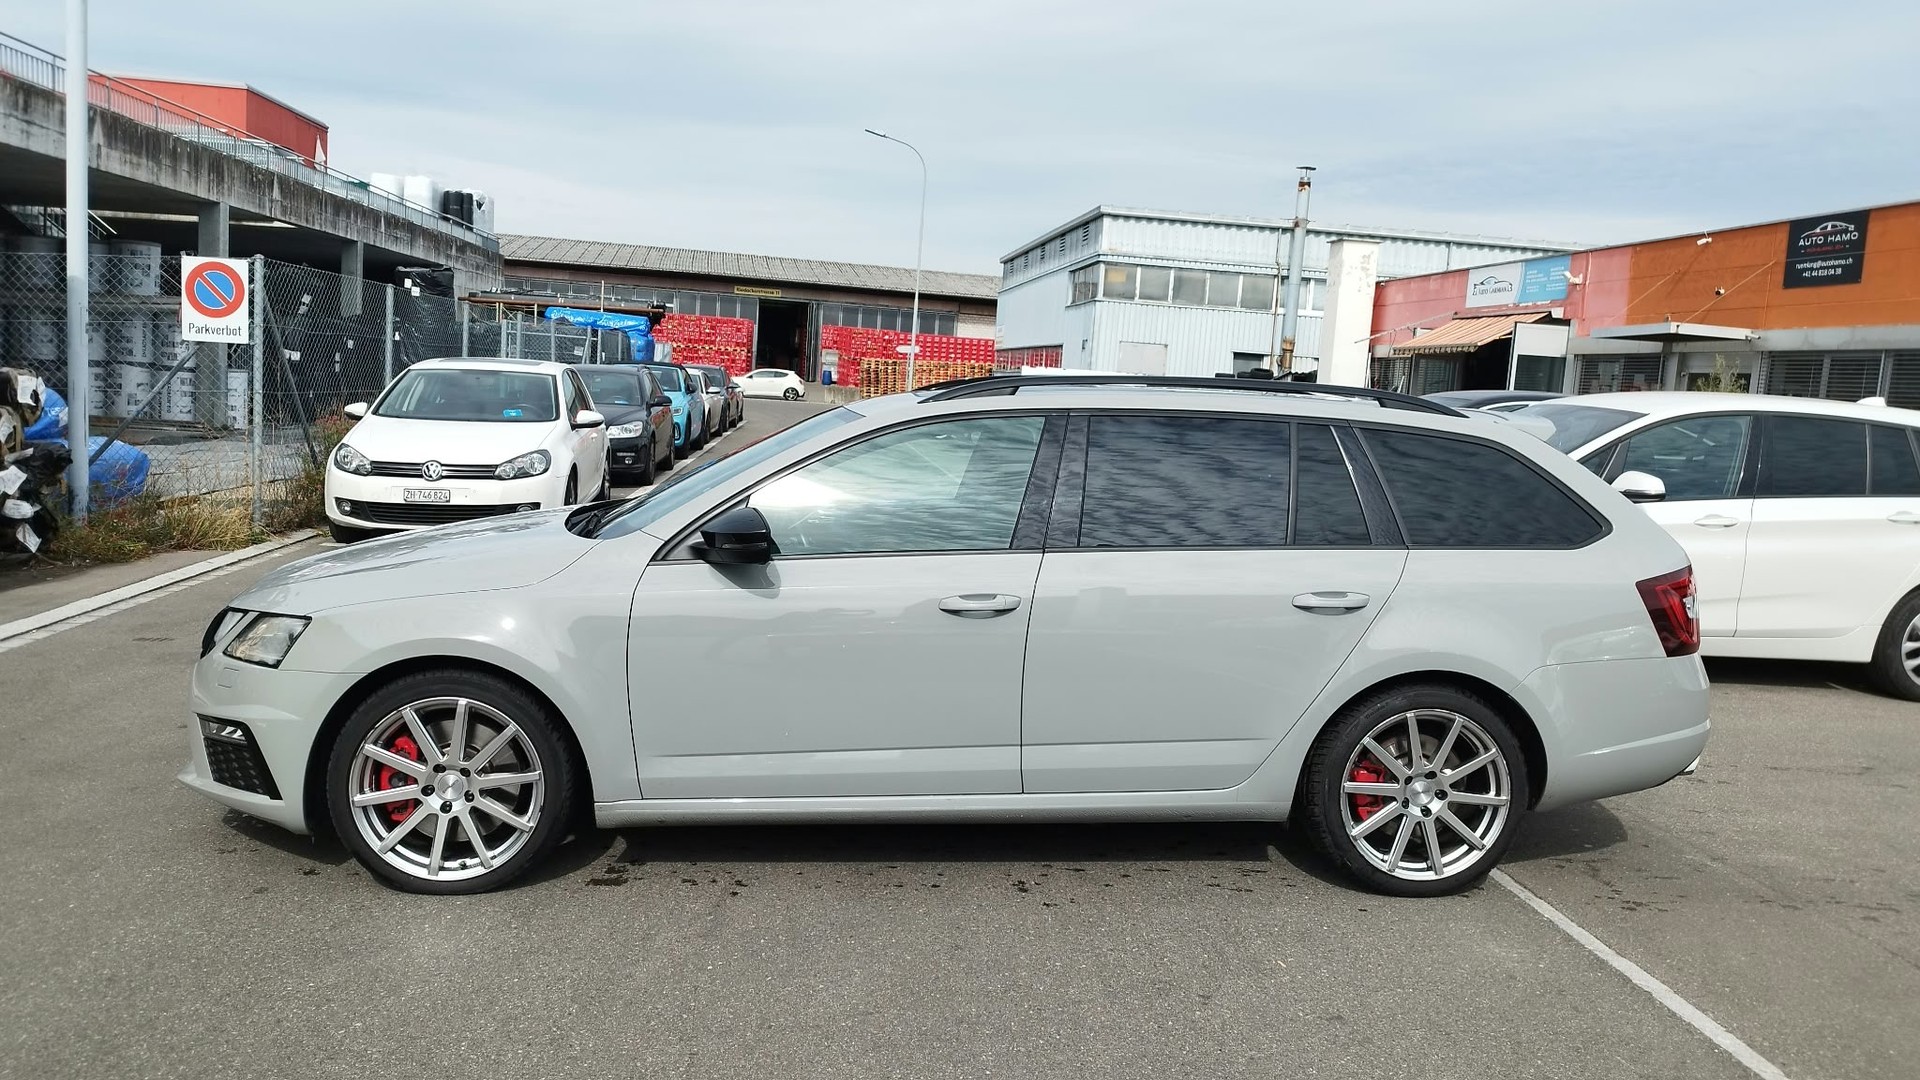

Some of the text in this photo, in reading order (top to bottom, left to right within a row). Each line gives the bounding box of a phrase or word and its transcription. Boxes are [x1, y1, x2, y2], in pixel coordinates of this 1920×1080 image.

[1798, 232, 1858, 246] AUTO HAMO
[188, 322, 242, 336] Parkverbot
